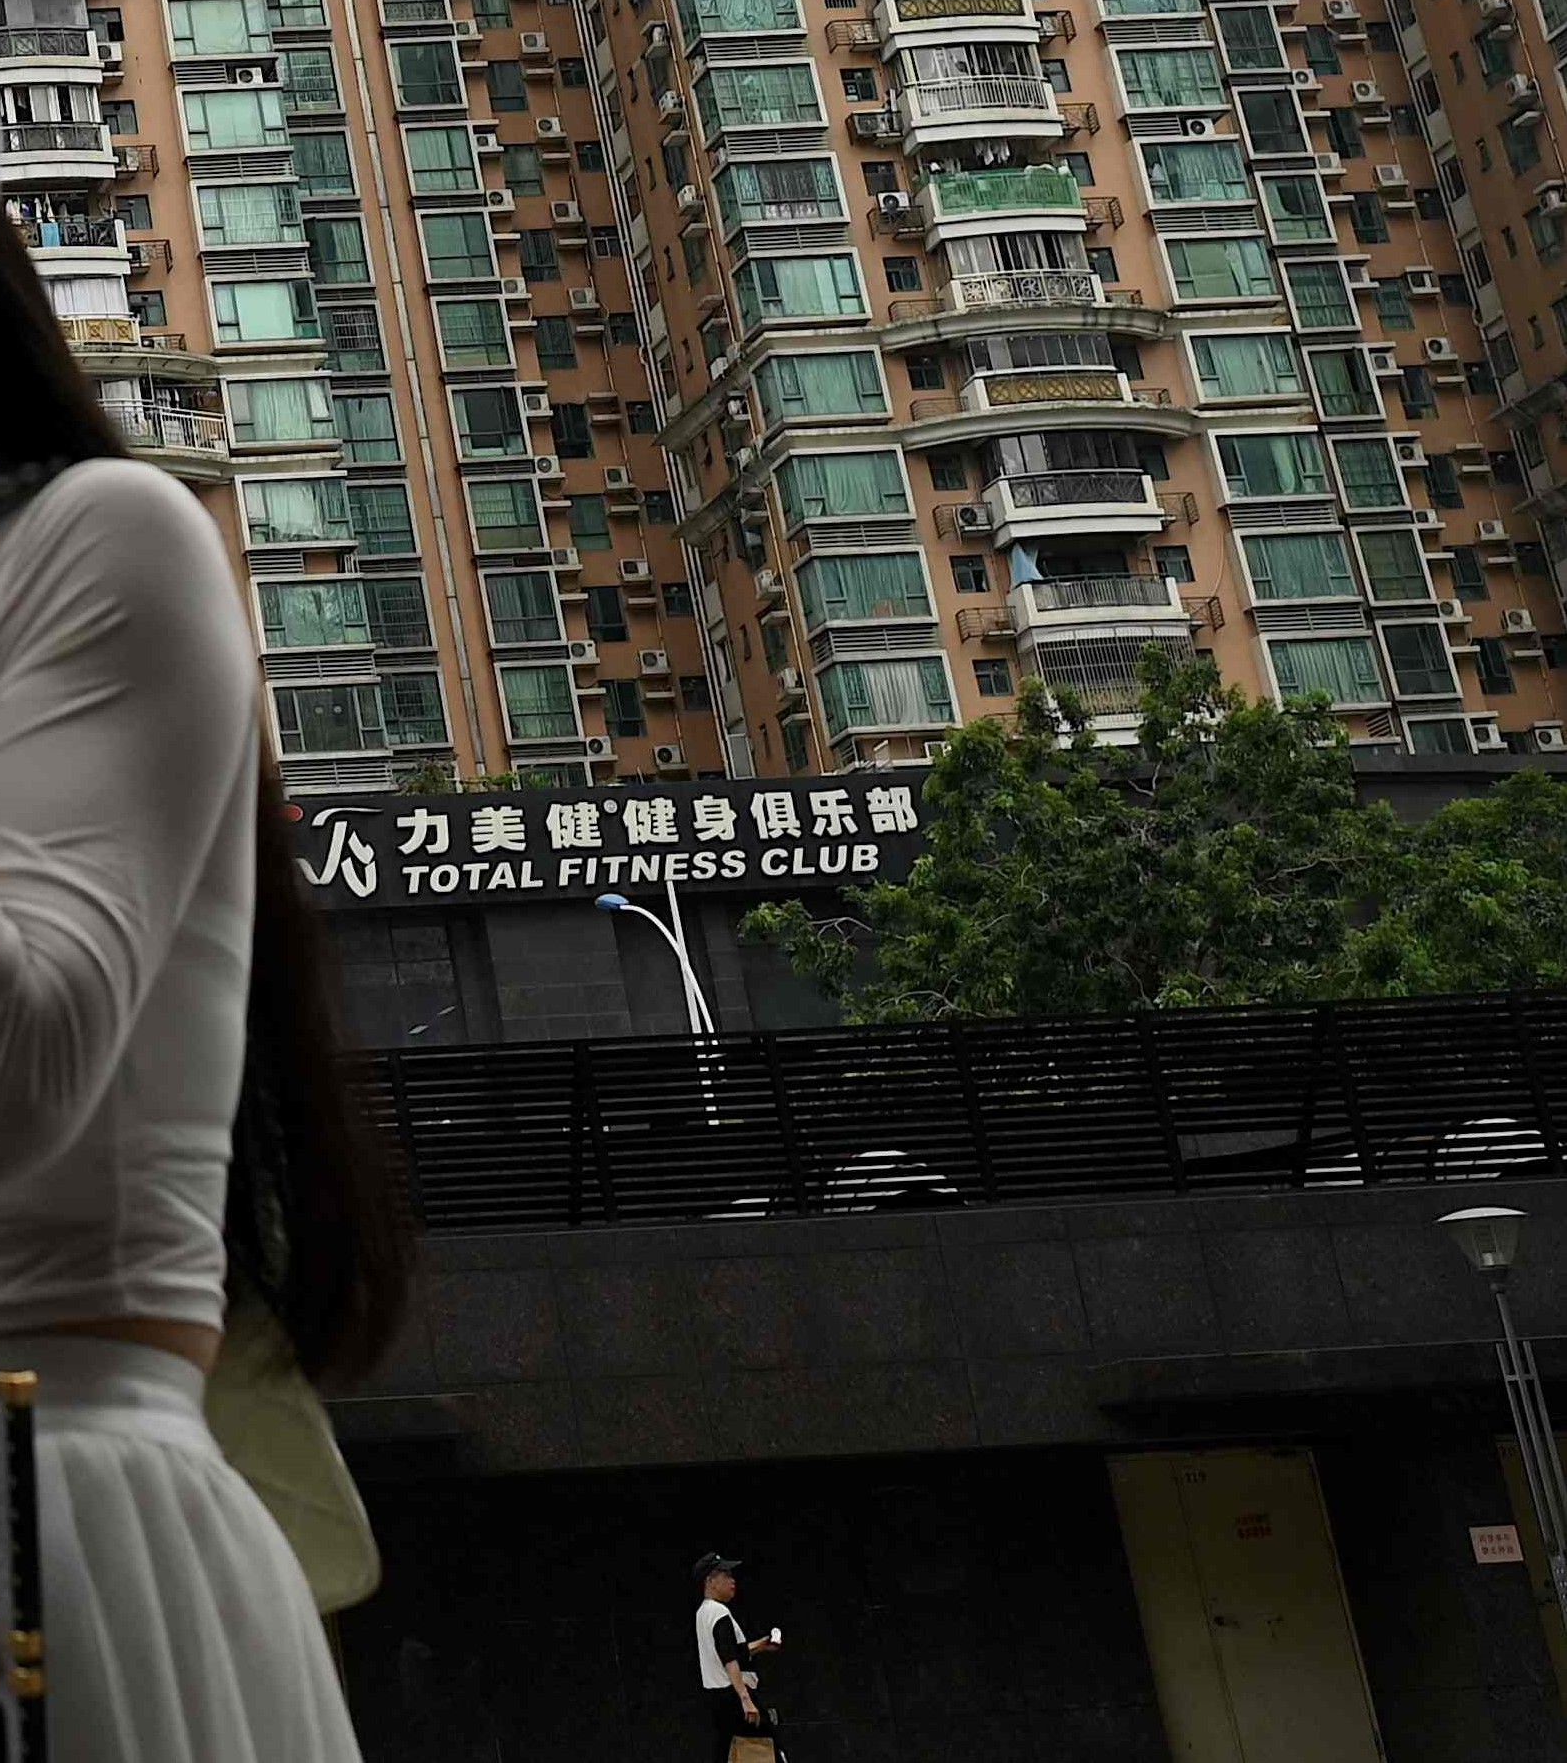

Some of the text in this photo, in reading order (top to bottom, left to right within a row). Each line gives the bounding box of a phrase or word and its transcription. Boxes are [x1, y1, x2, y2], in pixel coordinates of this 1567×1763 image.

[402, 842, 880, 895] TOTAL FITNESS CLUB
